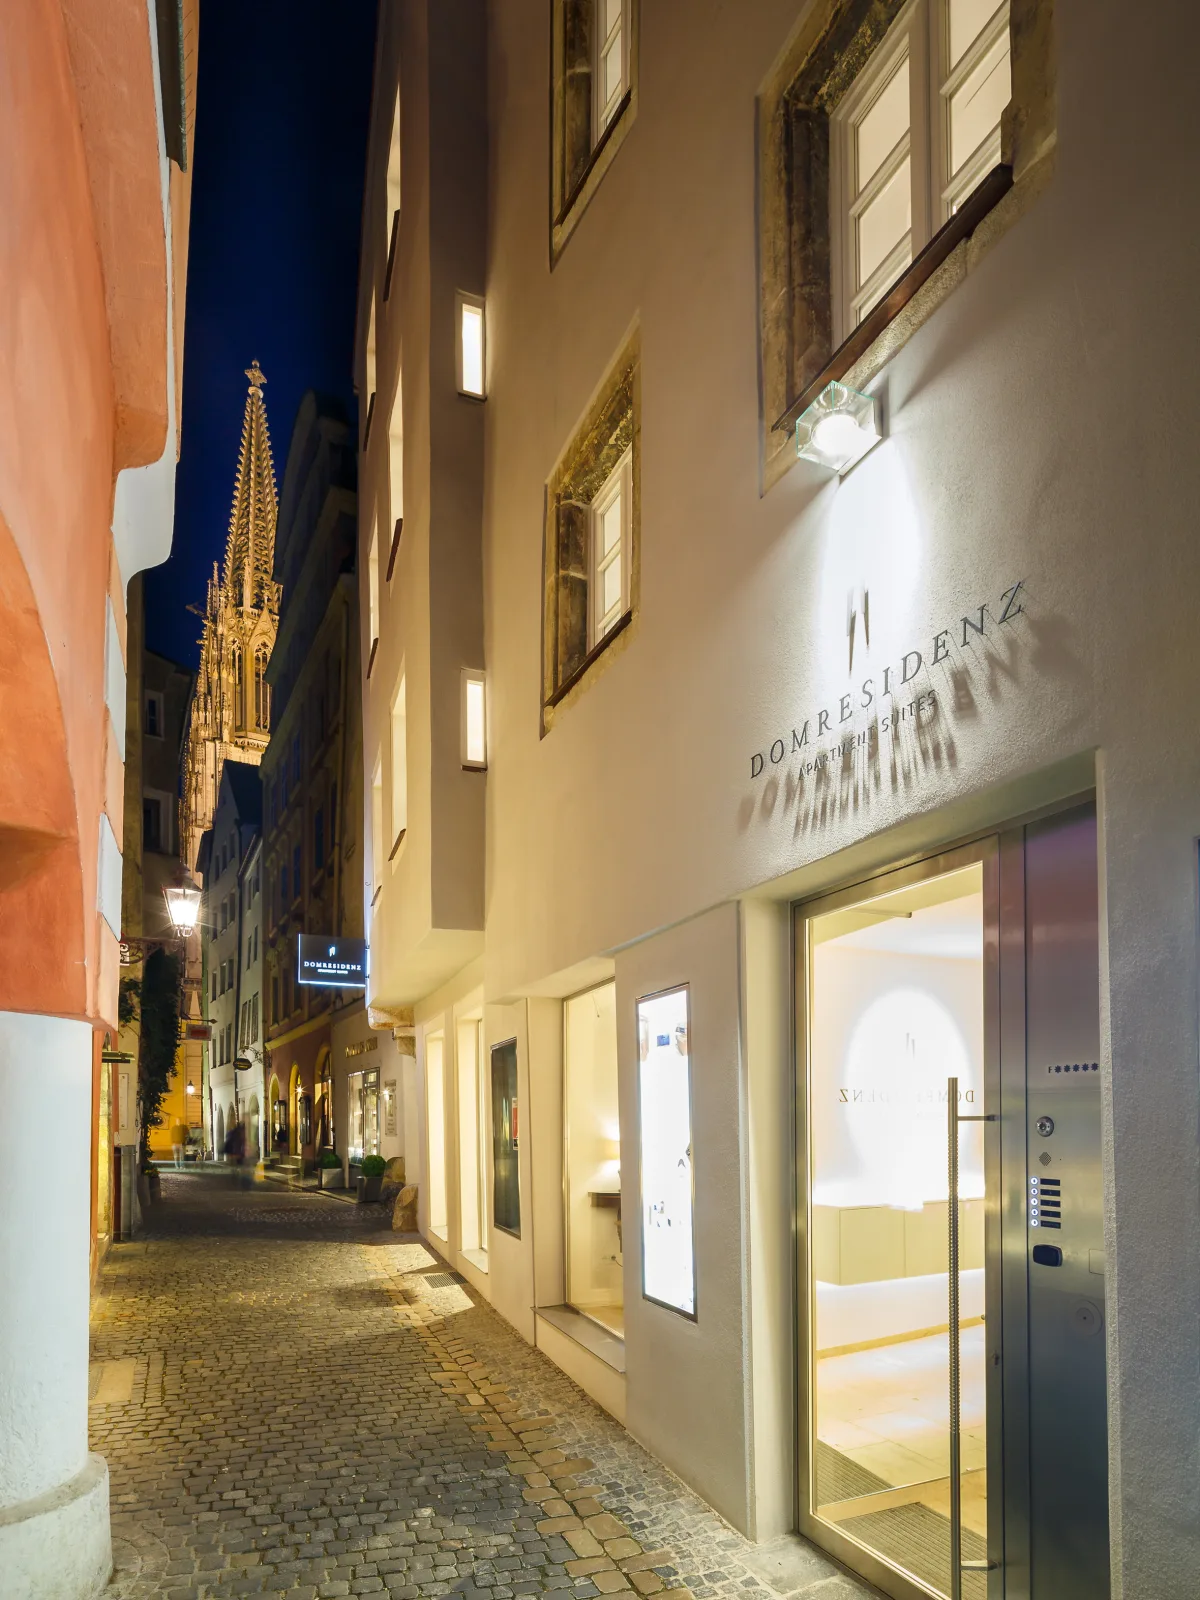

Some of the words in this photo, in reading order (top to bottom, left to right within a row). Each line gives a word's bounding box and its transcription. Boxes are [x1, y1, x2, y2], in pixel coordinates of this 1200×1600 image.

[749, 580, 1025, 779] DOMRESIDENZ
[798, 725, 877, 781] APARTMENT
[881, 689, 937, 733] SUITES
[303, 961, 362, 971] DOMRESIDENZ
